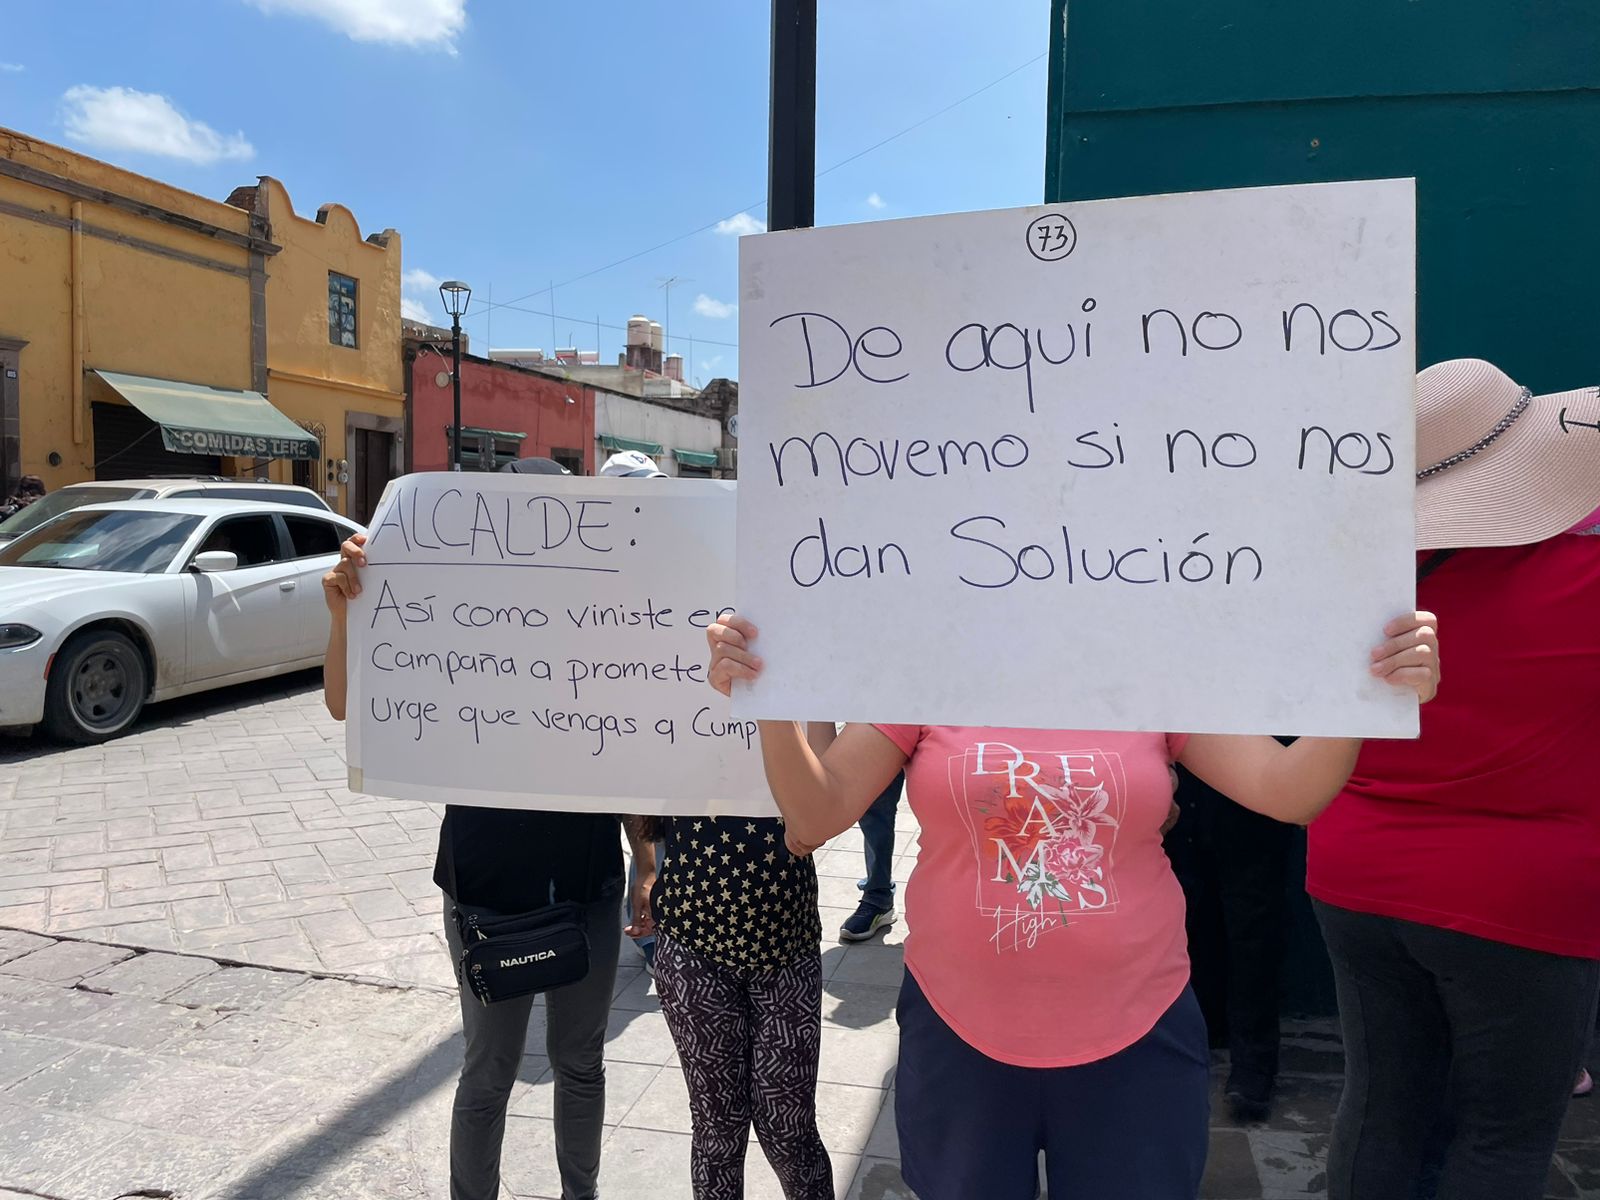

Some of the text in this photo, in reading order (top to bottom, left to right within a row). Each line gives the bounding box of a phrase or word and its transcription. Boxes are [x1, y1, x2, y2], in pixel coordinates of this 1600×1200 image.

[1037, 225, 1069, 253] 73
[770, 313, 910, 389] De
[1142, 308, 1243, 357] no
[1283, 302, 1402, 356] nos
[770, 422, 1395, 487] movemo si no nos
[790, 515, 1263, 589] dan Solución
[371, 579, 437, 631] Así
[452, 602, 549, 628] como
[566, 597, 673, 630] viniste
[371, 642, 711, 700] Campaña a promete
[371, 697, 439, 742] Urge
[458, 705, 521, 745] que
[531, 708, 638, 757] vengas
[989, 900, 1059, 954] High
[500, 949, 557, 968] NAUTICA
